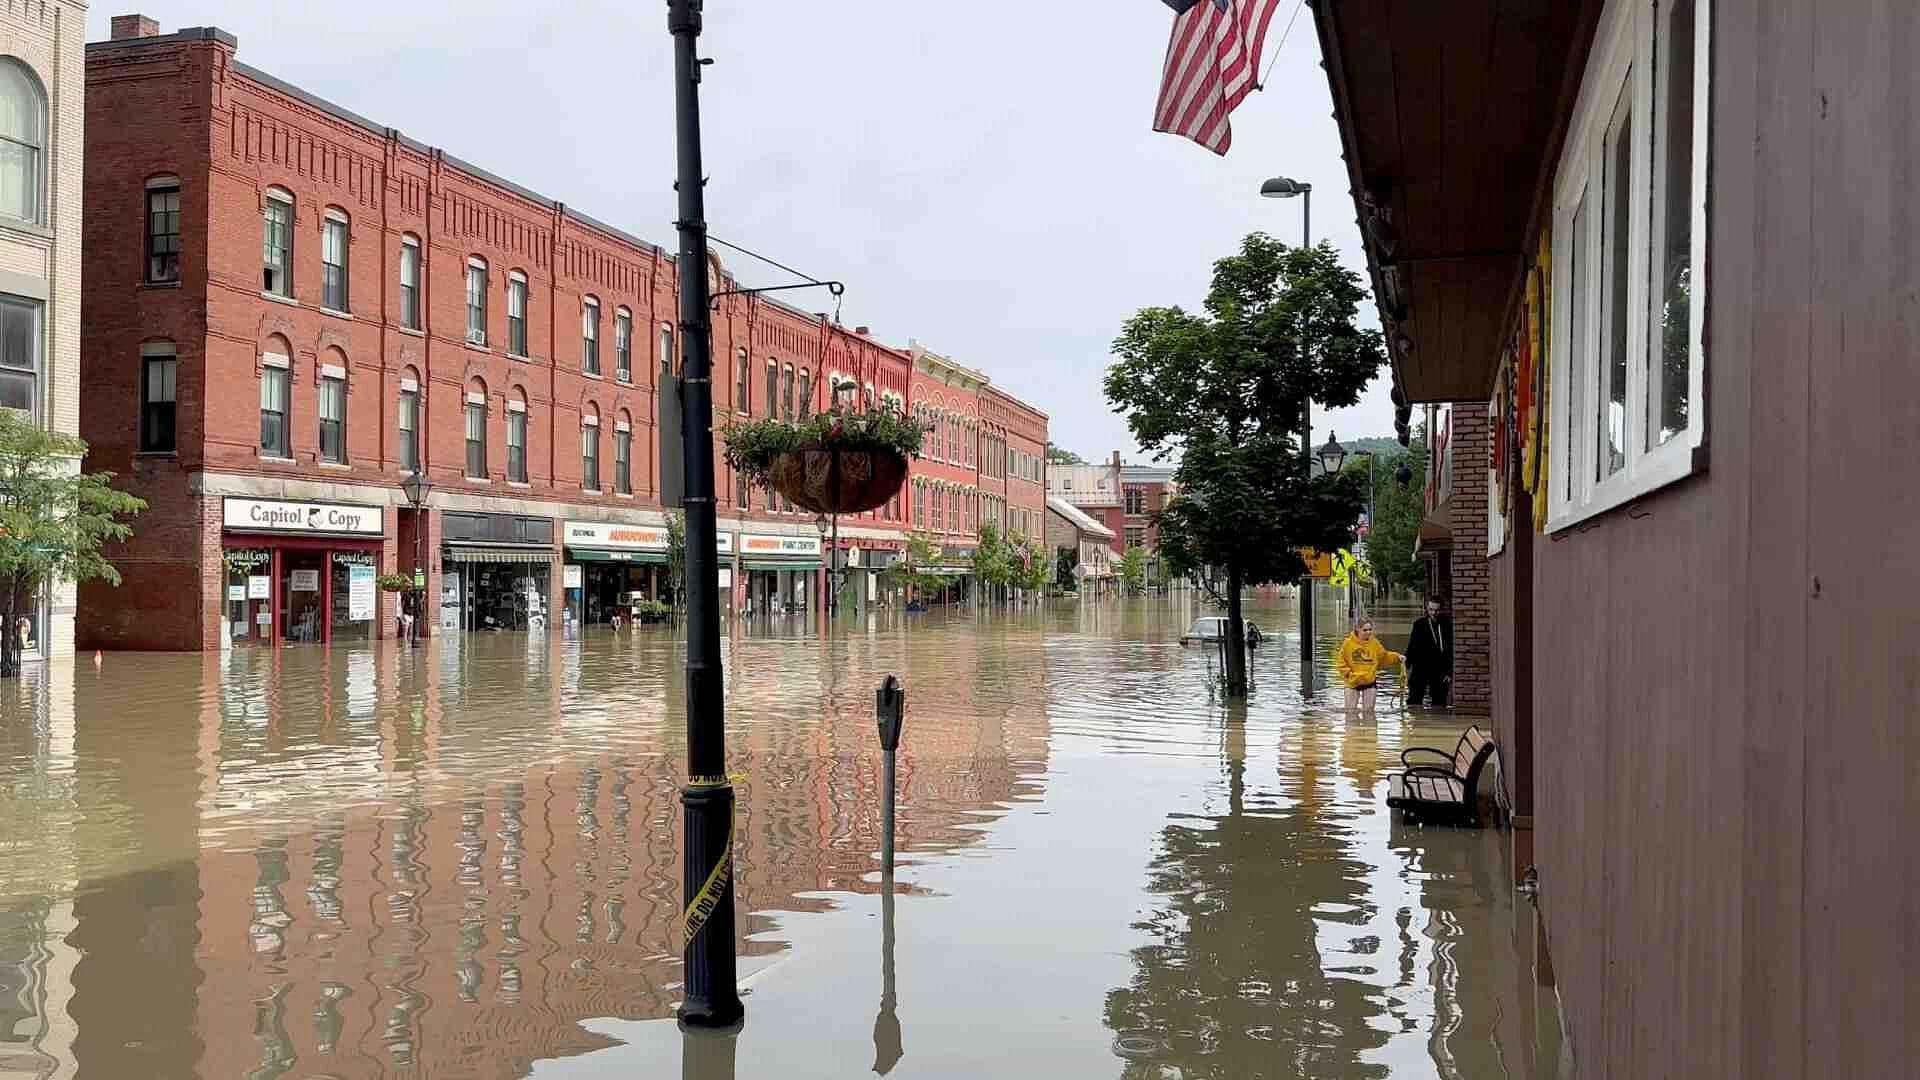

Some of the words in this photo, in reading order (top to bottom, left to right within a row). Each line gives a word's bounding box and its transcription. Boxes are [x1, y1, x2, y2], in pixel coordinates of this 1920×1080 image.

[250, 505, 302, 527] Capitol
[328, 510, 361, 529] Copy
[696, 898, 713, 915] DO
